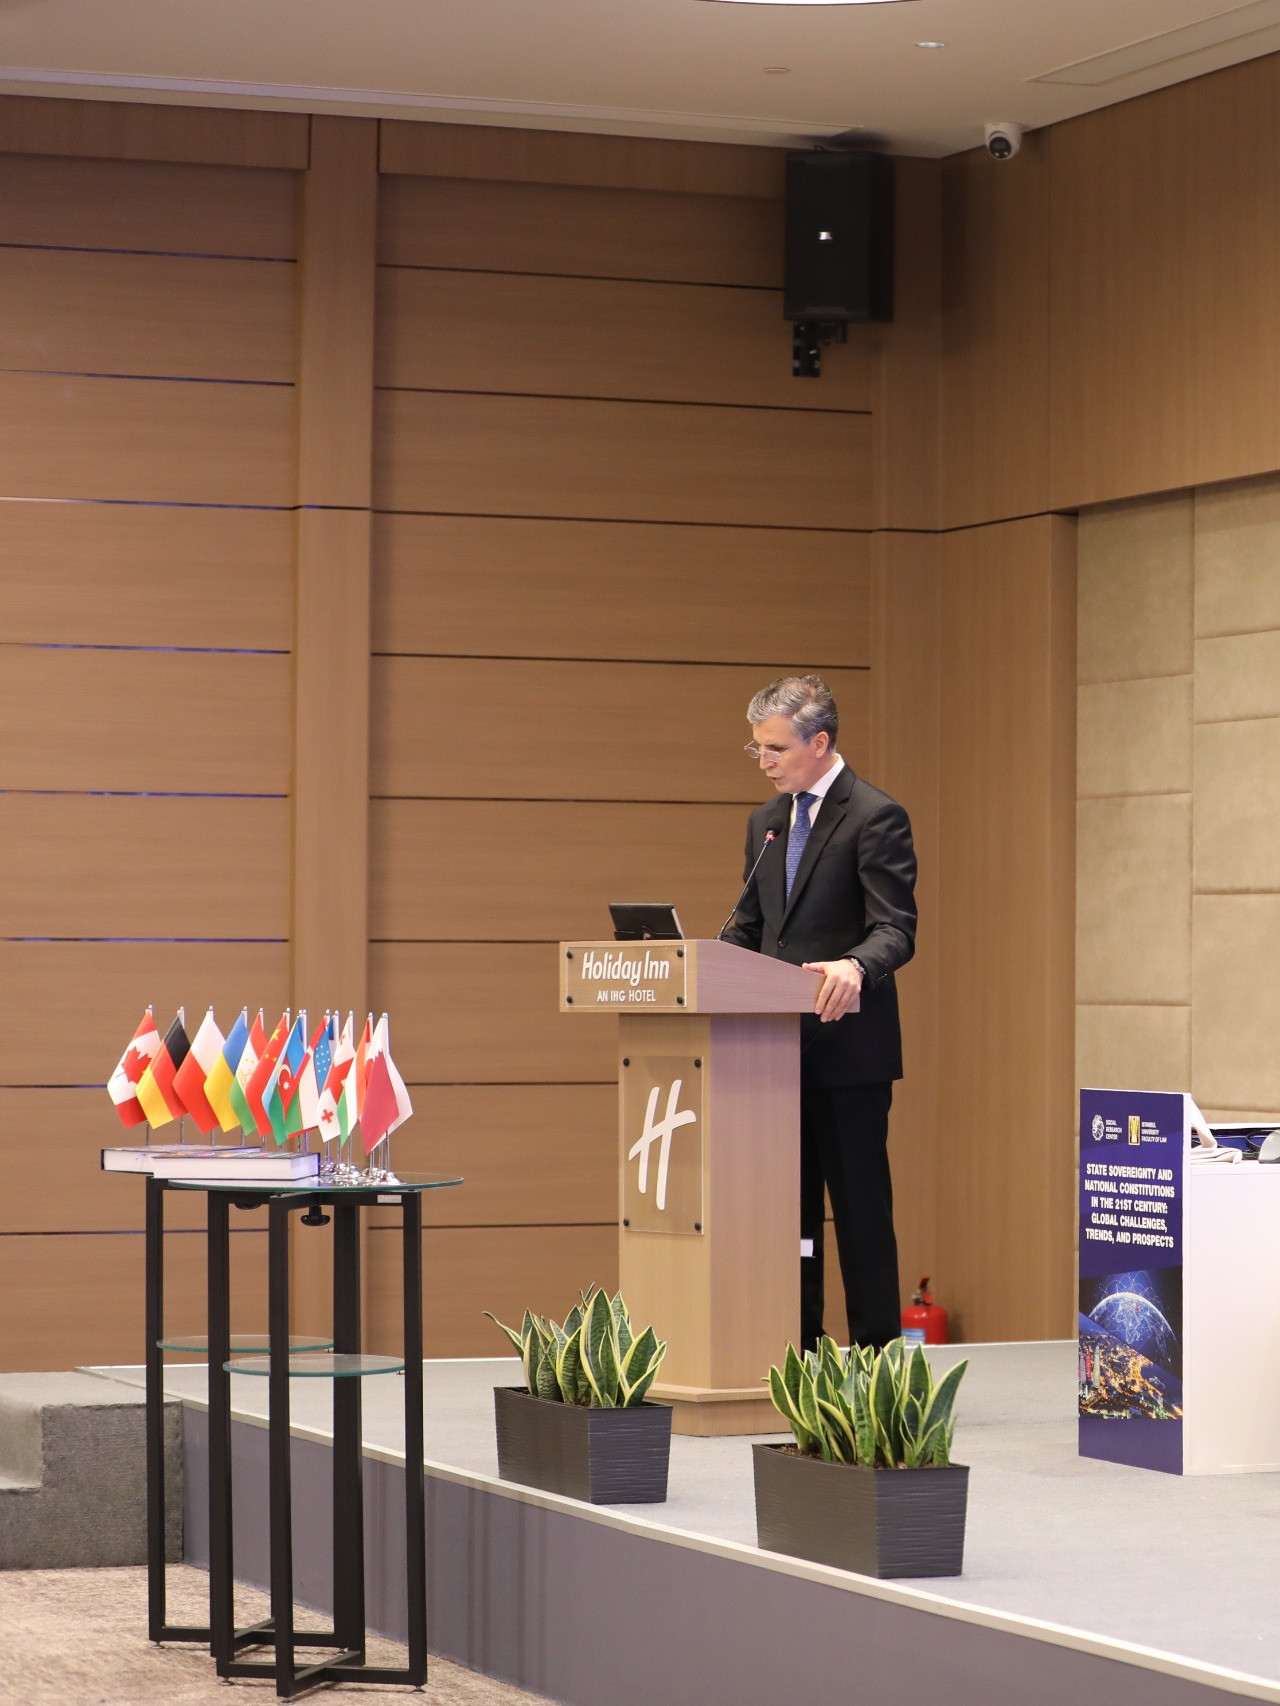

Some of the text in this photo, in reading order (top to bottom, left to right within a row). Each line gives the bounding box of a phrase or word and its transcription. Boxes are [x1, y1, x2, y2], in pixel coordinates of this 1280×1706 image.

[582, 950, 670, 986] Holiday Inn
[597, 990, 656, 1002] AN IHG HOTEL
[1087, 1164, 1172, 1181] STATE SOVEREIGNTY AND
[1085, 1180, 1175, 1198] NATIONAL CONSTITUTIONS
[1091, 1196, 1168, 1214] IN THE 21ST CENTURY:
[1092, 1213, 1167, 1232] GLOBAL CHALLENGES,
[1086, 1228, 1173, 1248] TRENDS, AND PROSPECTS
